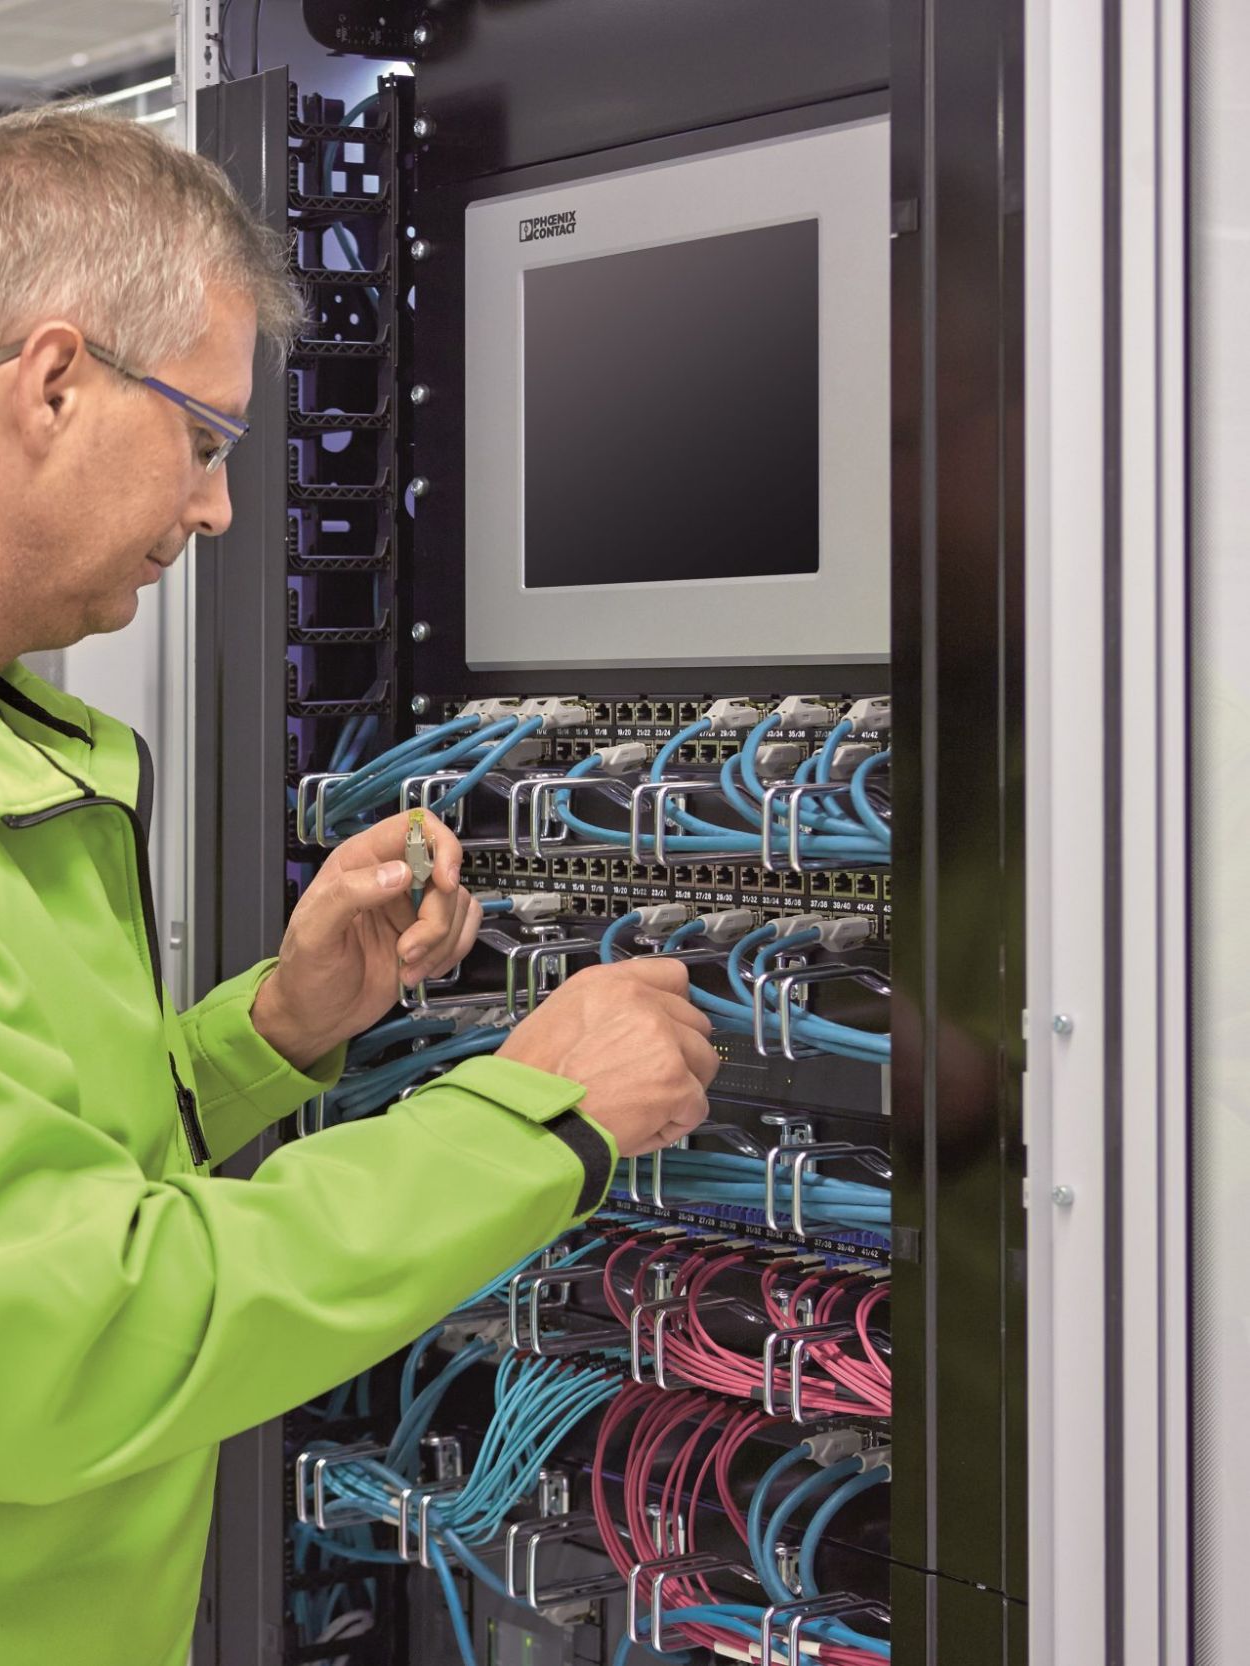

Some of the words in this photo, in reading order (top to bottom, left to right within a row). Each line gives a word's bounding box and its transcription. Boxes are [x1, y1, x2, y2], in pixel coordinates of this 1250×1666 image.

[534, 223, 576, 239] CONTACT
[617, 728, 631, 736] 19/20
[636, 728, 651, 736] 21/22
[655, 728, 671, 737] 23/24
[861, 731, 878, 739] 41/42
[613, 886, 628, 894] 19/20
[632, 888, 647, 896] 21/22
[651, 889, 667, 897] 23/24
[695, 891, 711, 900] 27/28
[716, 893, 733, 901] 29/30
[742, 895, 758, 904] 31/32
[762, 896, 779, 905] 33/34
[810, 900, 828, 908] 37/38
[833, 901, 851, 910] 39/40
[857, 903, 874, 912] 41/42
[746, 1225, 761, 1235] 31/32
[814, 1239, 832, 1249] 37/38
[837, 1242, 856, 1253] 39/40
[861, 1248, 879, 1258] 41/42
